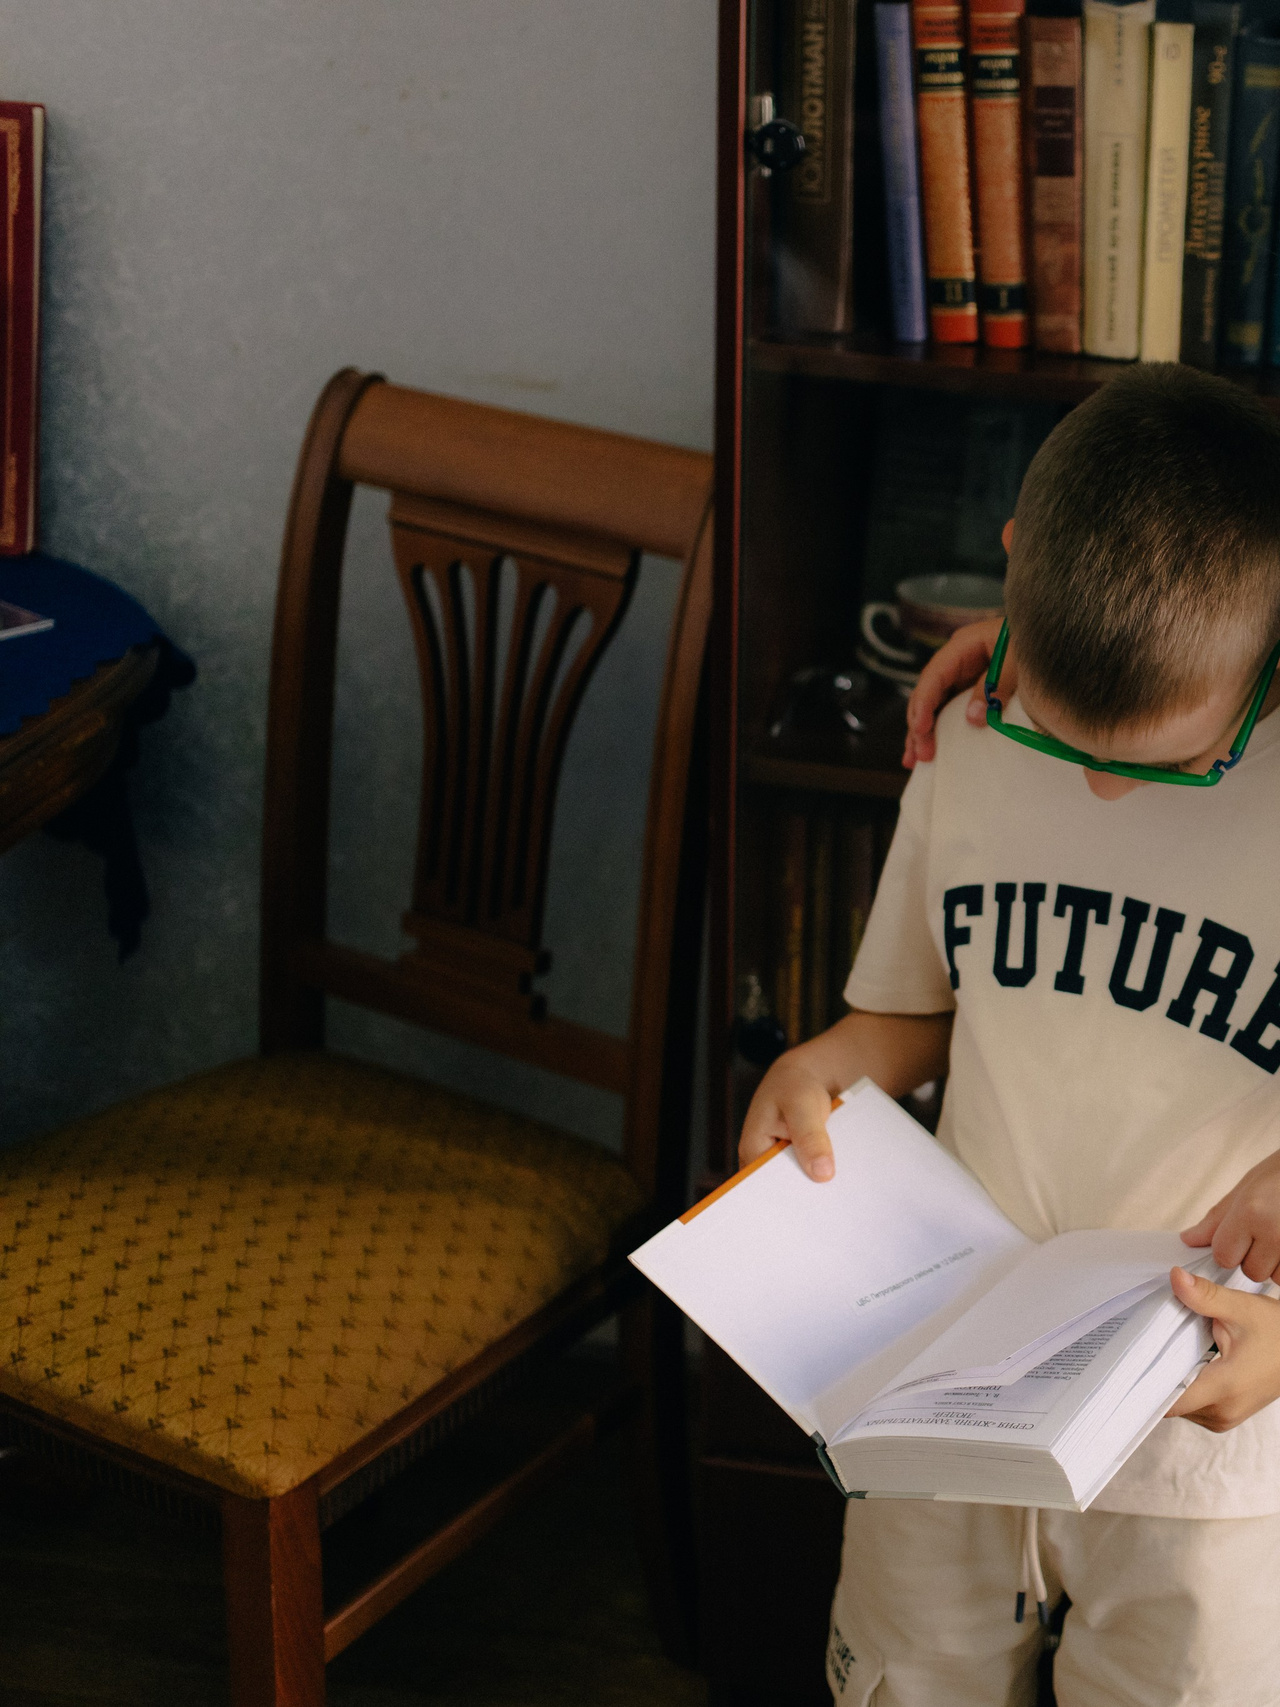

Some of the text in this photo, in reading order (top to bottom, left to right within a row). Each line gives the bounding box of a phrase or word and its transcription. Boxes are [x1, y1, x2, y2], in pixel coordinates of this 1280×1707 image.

[855, 1295, 872, 1308] ЦБС
[870, 1276, 915, 1301] Петроградского
[865, 1418, 1034, 1430] СЕРИЯ «ЖИЗНЬ ЗАМЕЧАТЕЛЬНЫХ
